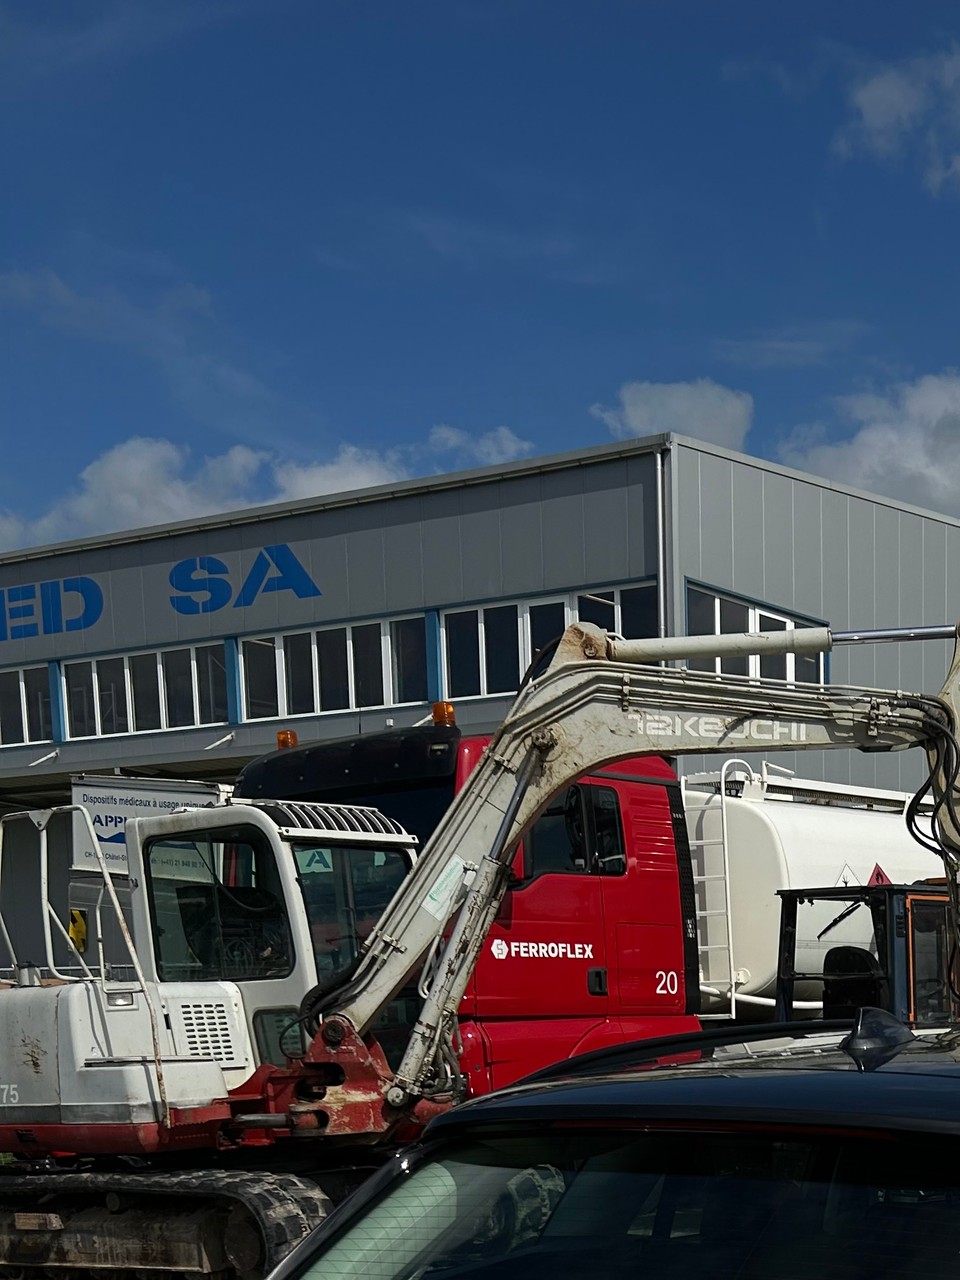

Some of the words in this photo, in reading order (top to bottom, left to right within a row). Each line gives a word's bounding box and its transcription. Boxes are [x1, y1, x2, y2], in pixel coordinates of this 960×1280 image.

[169, 544, 322, 615] SA
[82, 793, 118, 806] Dispositifs
[118, 796, 151, 808] médicaux
[153, 799, 158, 808] à
[159, 801, 180, 811] usage
[510, 941, 594, 959] FERROFLEX
[655, 971, 678, 995] 20
[0, 1084, 19, 1104] 75
